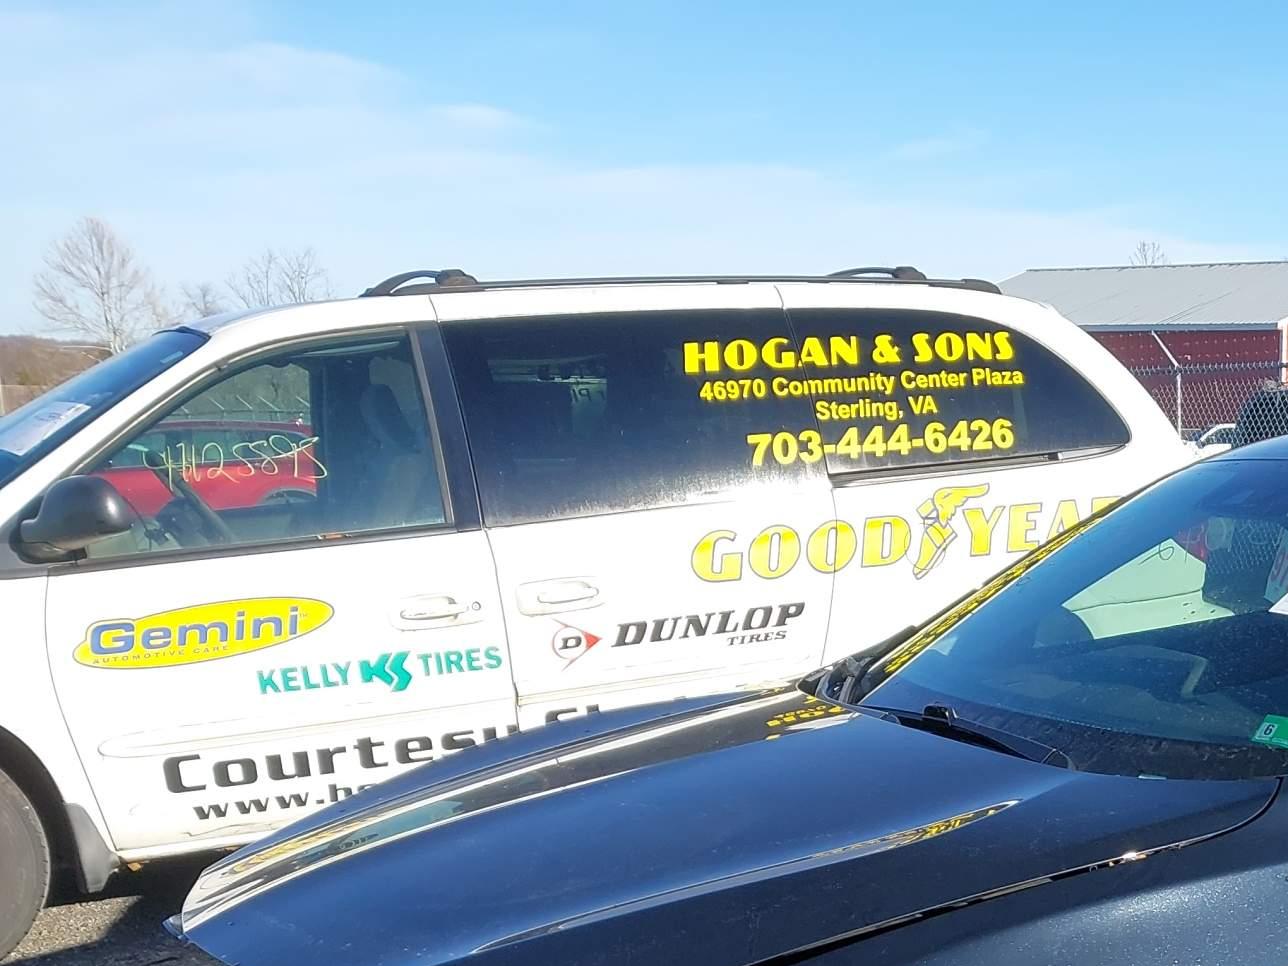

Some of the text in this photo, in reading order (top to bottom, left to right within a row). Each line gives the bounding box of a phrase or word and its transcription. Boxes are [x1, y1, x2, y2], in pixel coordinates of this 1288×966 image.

[684, 331, 1014, 373] HOGAN & SONS
[700, 367, 1025, 401] 46970 Community Center Plaza
[815, 395, 938, 421] Sterling, VA
[746, 418, 1015, 466] 703-444-6426
[90, 606, 299, 655] Gemini
[610, 601, 805, 648] DUNLOP
[727, 630, 788, 647] TIRES
[92, 644, 230, 665] AUTOMOTIVE CARE
[256, 661, 352, 695] KELLY
[416, 646, 503, 677] TIRES
[1263, 723, 1275, 736] 6
